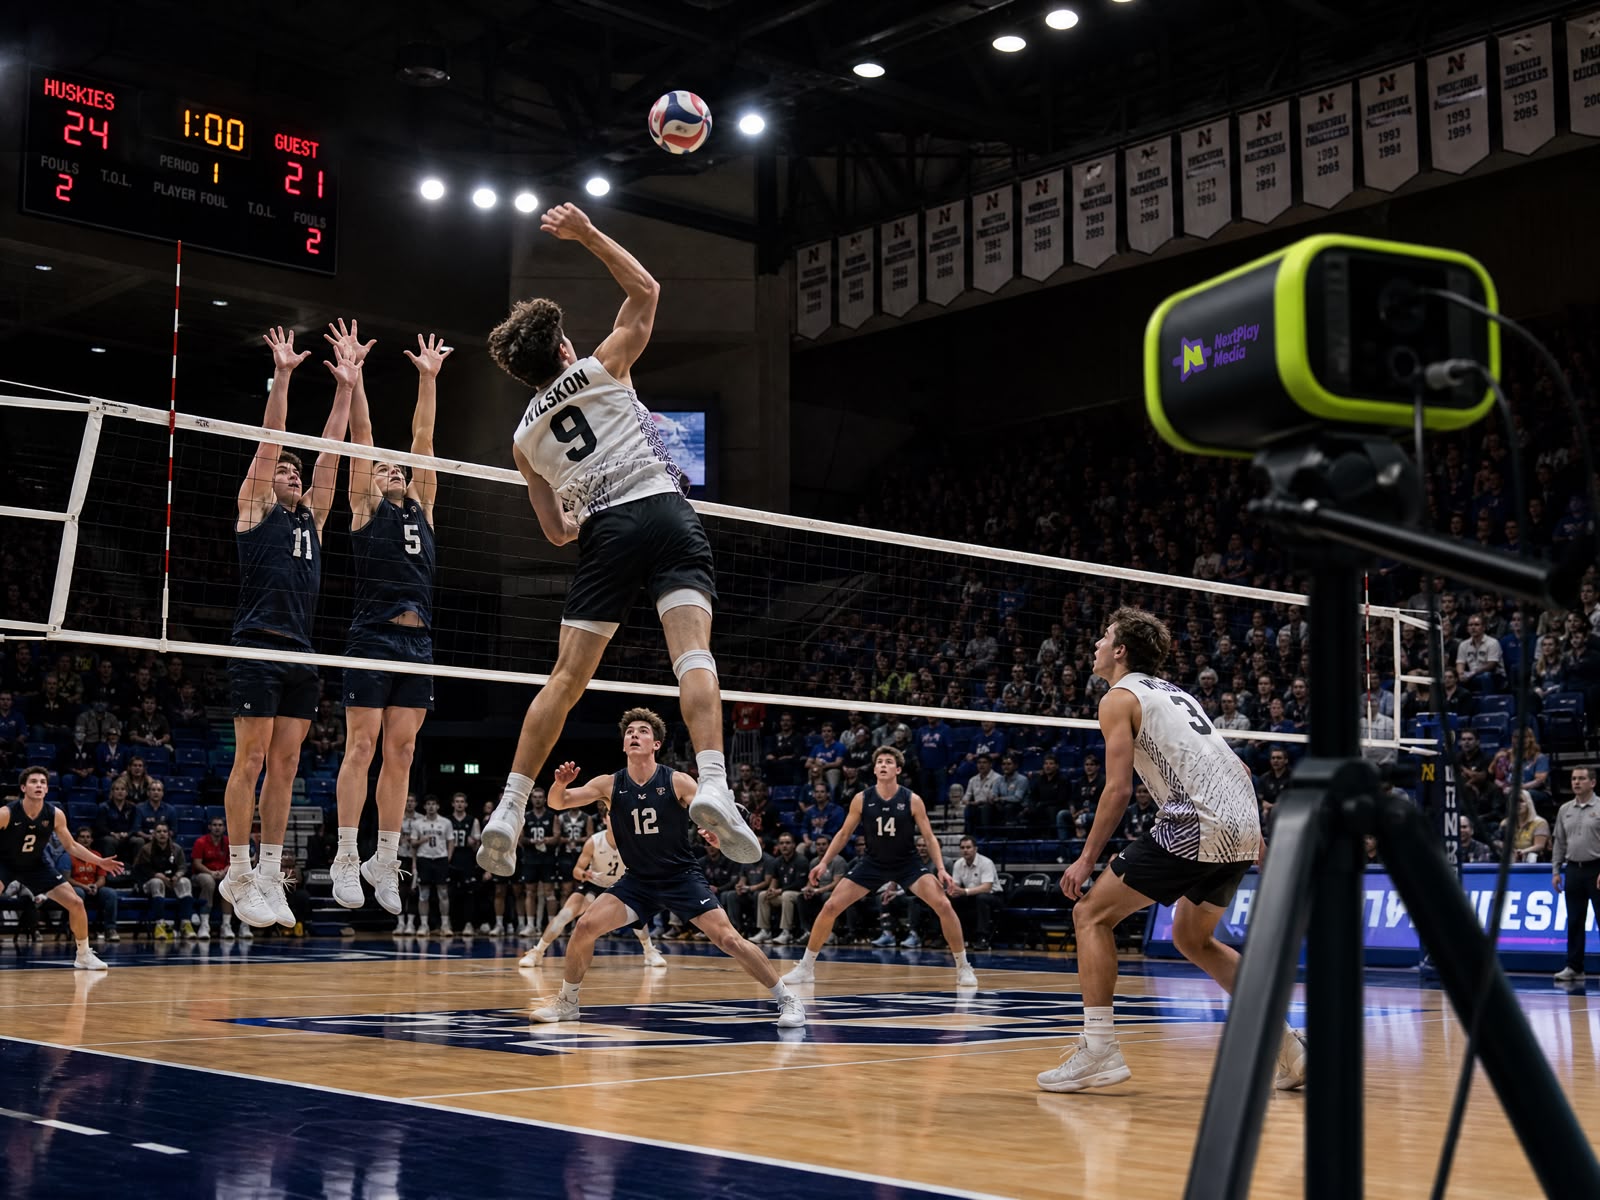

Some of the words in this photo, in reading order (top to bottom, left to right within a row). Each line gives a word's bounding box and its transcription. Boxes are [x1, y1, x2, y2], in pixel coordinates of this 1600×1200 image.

[1448, 53, 1466, 75] N
[44, 77, 116, 111] HUSKIES
[1378, 73, 1396, 95] N
[1318, 93, 1335, 114] N
[63, 110, 109, 150] 24
[184, 109, 244, 151] 1:00
[1256, 111, 1272, 131] N
[274, 133, 319, 159] GUEST
[41, 155, 80, 175] FOULS
[100, 169, 132, 188] T.O.L.
[159, 154, 200, 175] PERIOD
[213, 162, 219, 184] 1
[55, 173, 73, 202] 2
[284, 161, 324, 198] 21
[153, 181, 196, 202] PLAYER
[200, 191, 228, 209] FOUL
[248, 201, 277, 219] T.O.L.
[294, 211, 327, 229] FOULS
[306, 228, 321, 254] 2
[1214, 323, 1260, 350] NextPlay
[1213, 346, 1247, 368] Media
[524, 368, 591, 427] WILSKON
[550, 405, 598, 462] 9
[292, 527, 313, 560] 11
[404, 524, 421, 554] 5
[1169, 695, 1212, 735] 3
[631, 807, 660, 835] 12
[875, 816, 897, 837] 14
[22, 834, 37, 852] 2
